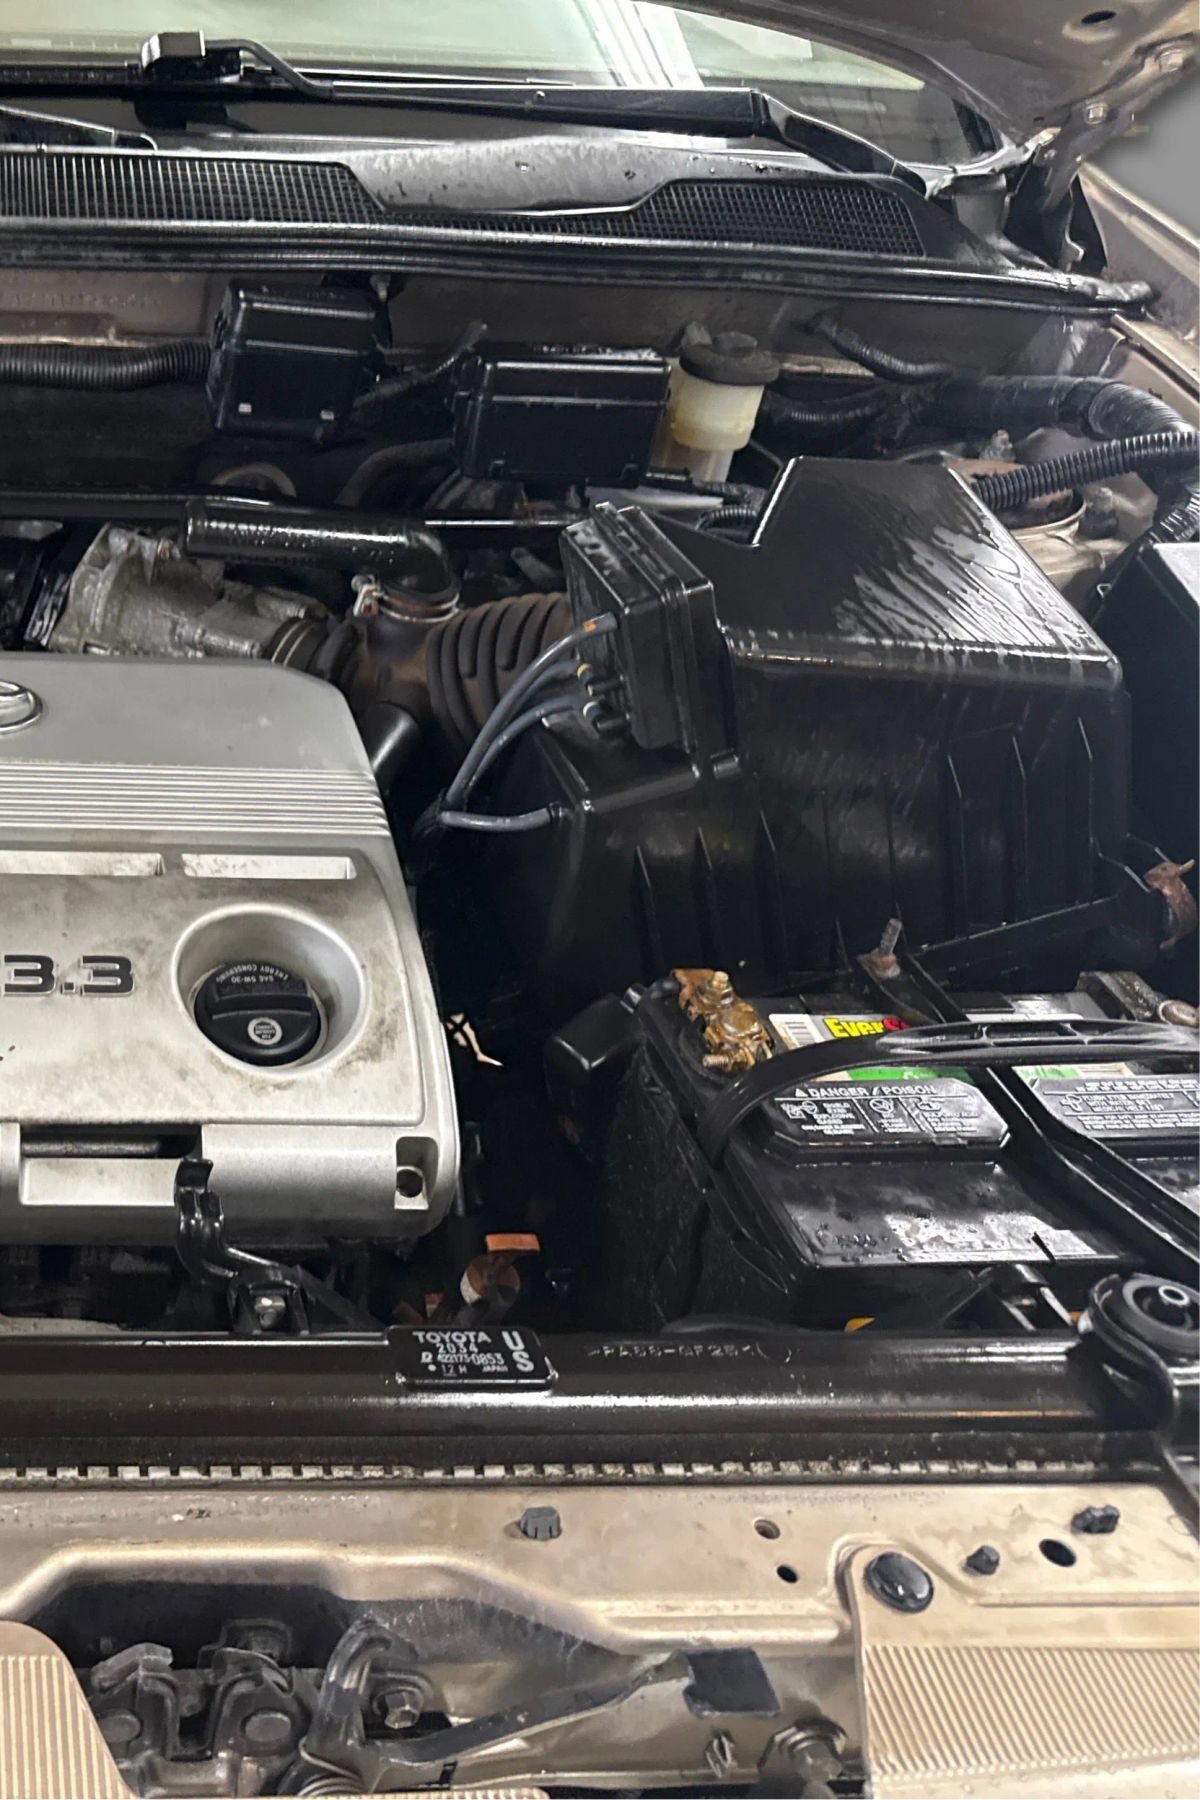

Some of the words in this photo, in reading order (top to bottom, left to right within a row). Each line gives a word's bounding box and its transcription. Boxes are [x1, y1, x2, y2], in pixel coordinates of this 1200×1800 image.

[3, 953, 136, 998] 3.3
[231, 975, 257, 983] 5W-30
[259, 975, 275, 983] SAE
[260, 965, 289, 981] ENERGY
[807, 1087, 869, 1098] DANGER
[883, 1085, 937, 1096] POISON
[412, 1331, 492, 1344] TOYOTA
[436, 1343, 479, 1354] 2034
